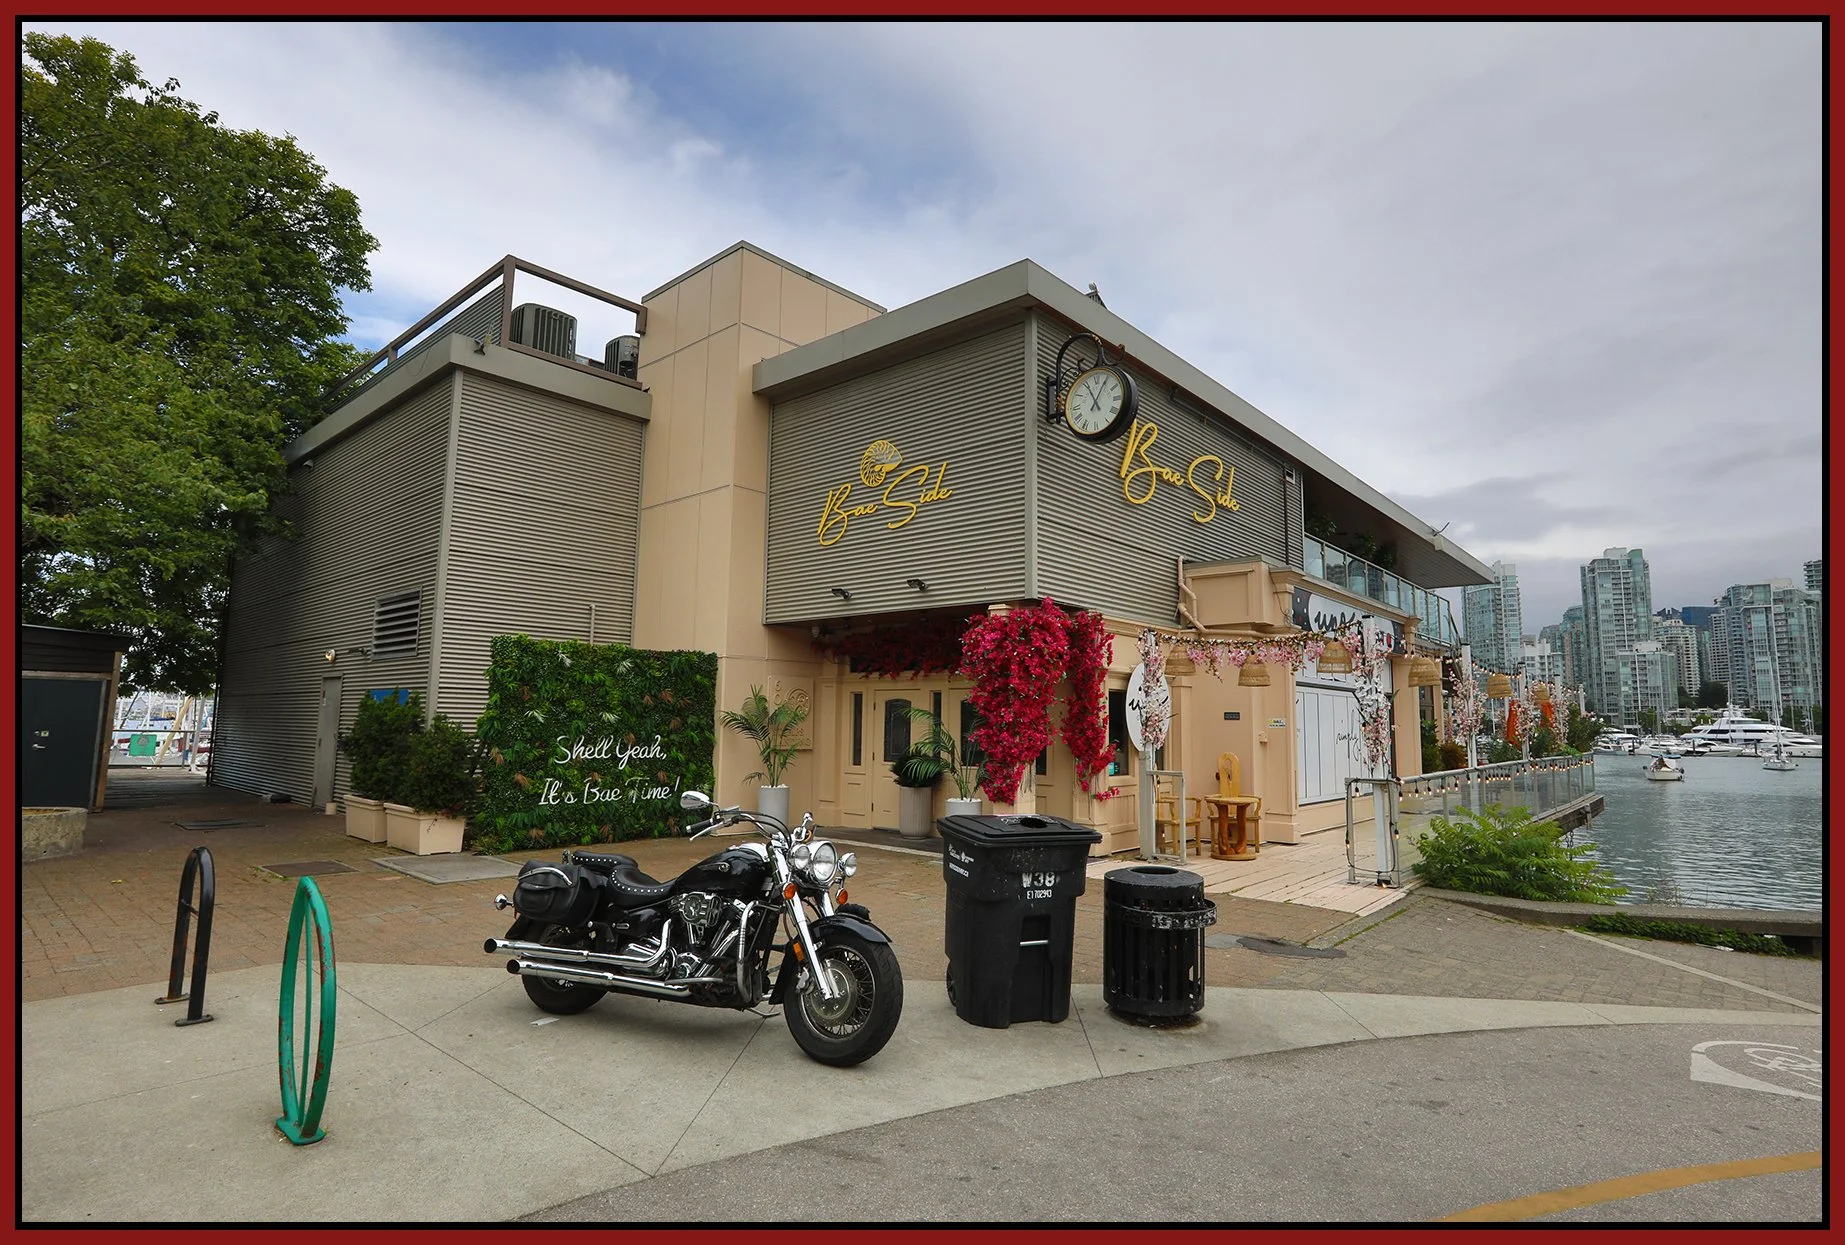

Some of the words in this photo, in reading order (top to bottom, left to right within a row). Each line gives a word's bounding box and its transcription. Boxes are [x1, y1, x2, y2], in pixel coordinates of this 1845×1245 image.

[1120, 418, 1184, 504] Bae
[1188, 455, 1240, 523] Side
[817, 483, 878, 546] Bae
[883, 461, 952, 529] Side
[554, 735, 613, 764] Shell
[616, 734, 667, 770] Yeah,
[538, 778, 578, 805] It's
[583, 777, 622, 804] Bae
[624, 776, 680, 804] Time!
